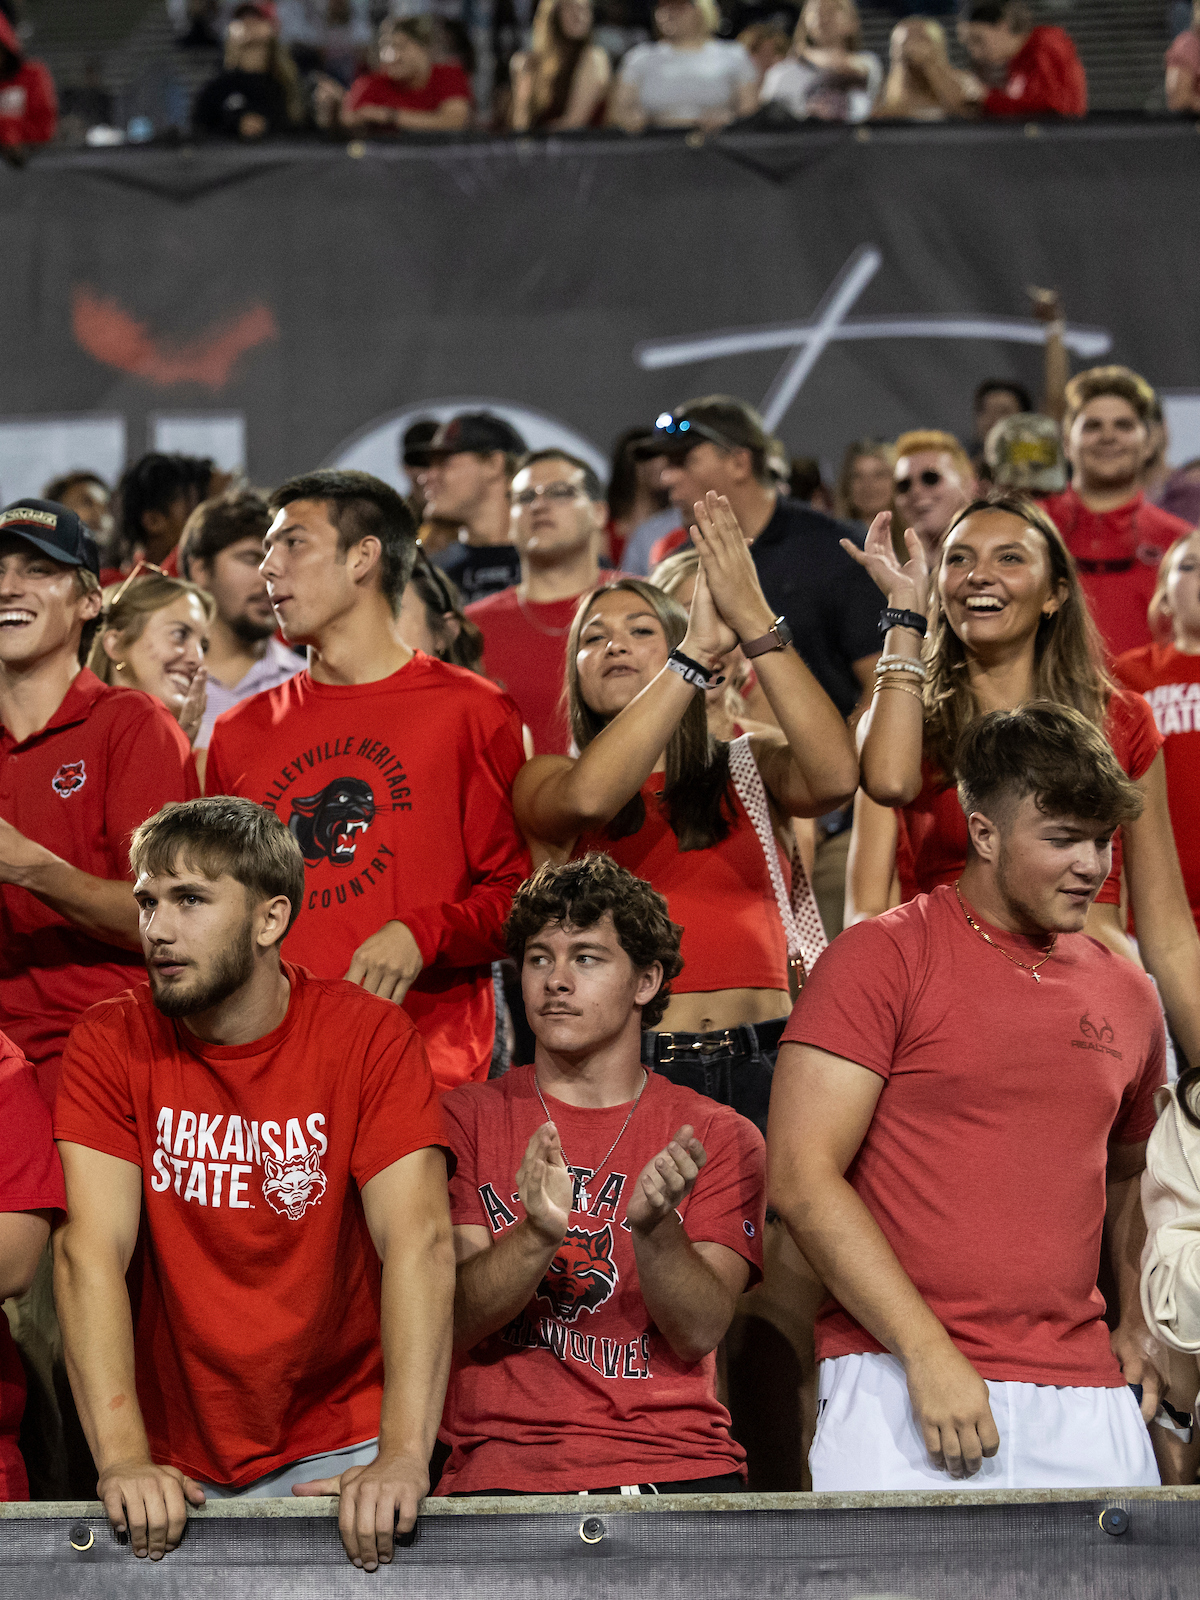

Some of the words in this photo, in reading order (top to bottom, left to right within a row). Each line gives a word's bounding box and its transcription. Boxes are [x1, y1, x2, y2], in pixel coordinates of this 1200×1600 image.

[261, 736, 355, 812] OLLEYVILLE
[356, 737, 412, 812] HERITAGE
[308, 843, 395, 910] COUNTRY
[155, 1106, 328, 1166] ARKANSAS
[150, 1147, 253, 1209] STATE
